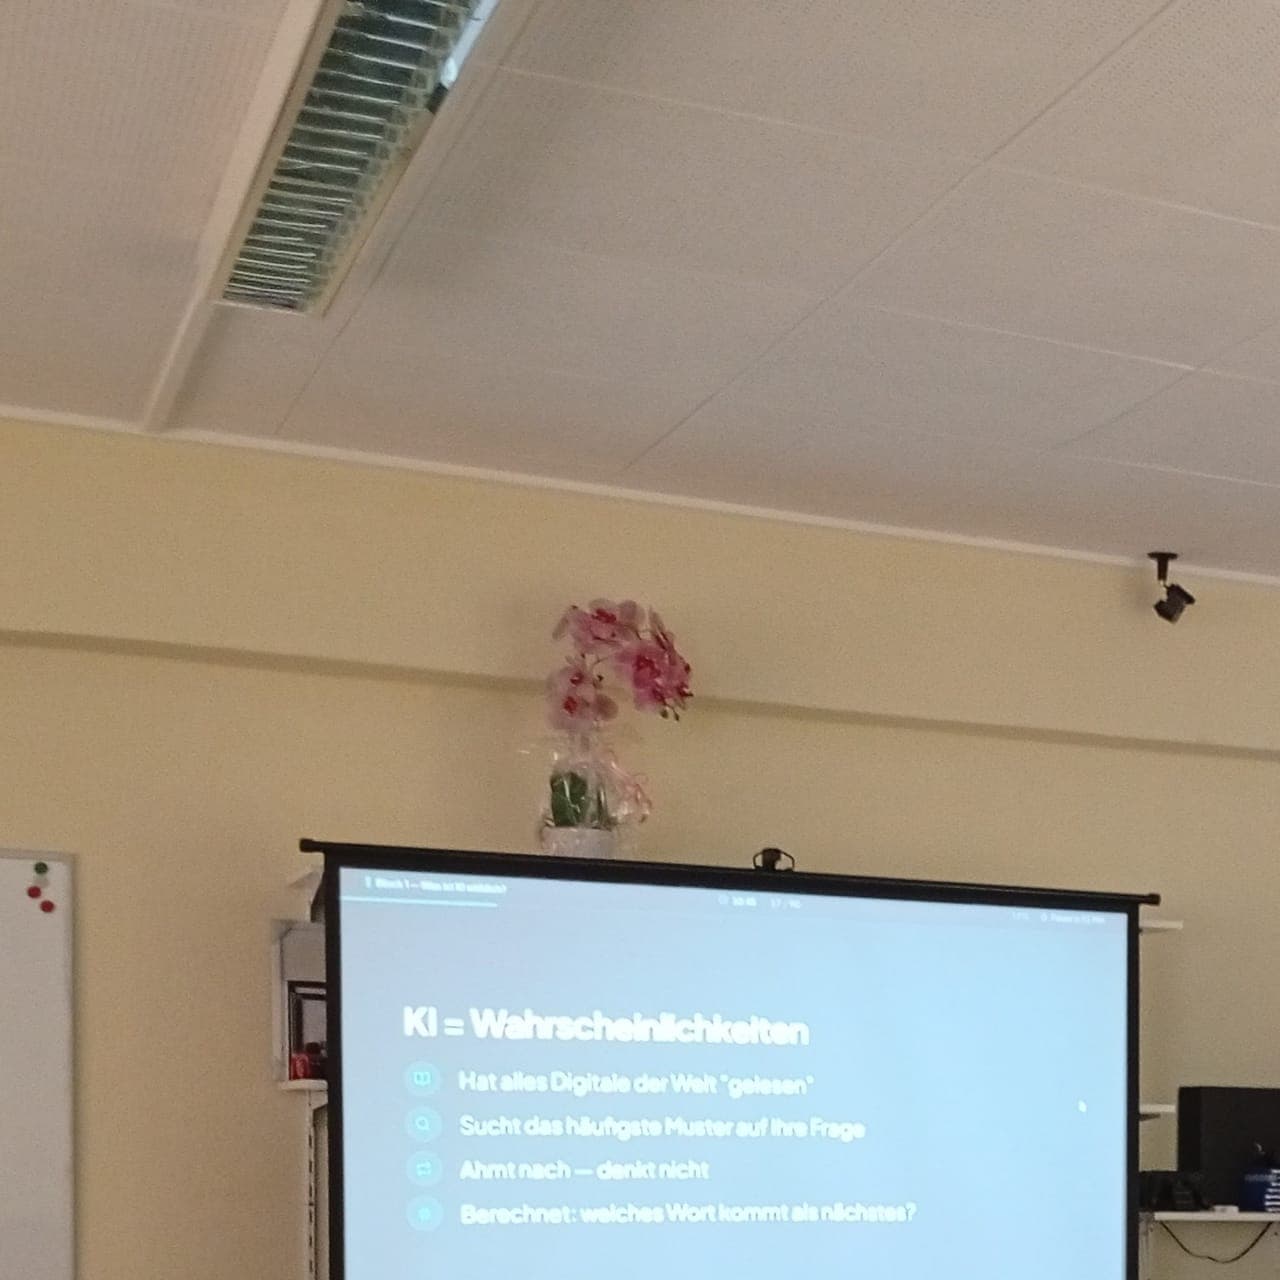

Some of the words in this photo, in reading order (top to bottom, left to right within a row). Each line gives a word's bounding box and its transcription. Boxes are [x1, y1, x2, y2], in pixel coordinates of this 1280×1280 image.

[403, 1006, 438, 1038] KI
[444, 1017, 465, 1036] =
[470, 1008, 809, 1045] Wahrscheinlichkeiten
[458, 1071, 498, 1092] Hat
[500, 1071, 549, 1093] alles
[550, 1071, 632, 1098] Digitale
[633, 1073, 669, 1094] der
[669, 1073, 718, 1095] Welt
[459, 1114, 522, 1137] Sucht
[523, 1115, 564, 1137] das
[565, 1115, 663, 1142] häufigste
[664, 1116, 735, 1138] Muster
[735, 1117, 769, 1138] auf
[770, 1117, 808, 1138] Ihre
[809, 1117, 867, 1143] Frage
[459, 1159, 516, 1180] Ahmt
[517, 1159, 571, 1180] nach
[596, 1159, 657, 1181] denkt
[658, 1159, 710, 1180] nicht
[460, 1203, 577, 1225] Berechnet:
[579, 1203, 665, 1224] welches
[665, 1202, 717, 1223] Wort
[718, 1202, 790, 1223] kommt
[791, 1202, 820, 1223] als
[820, 1201, 918, 1223] nächstes?
